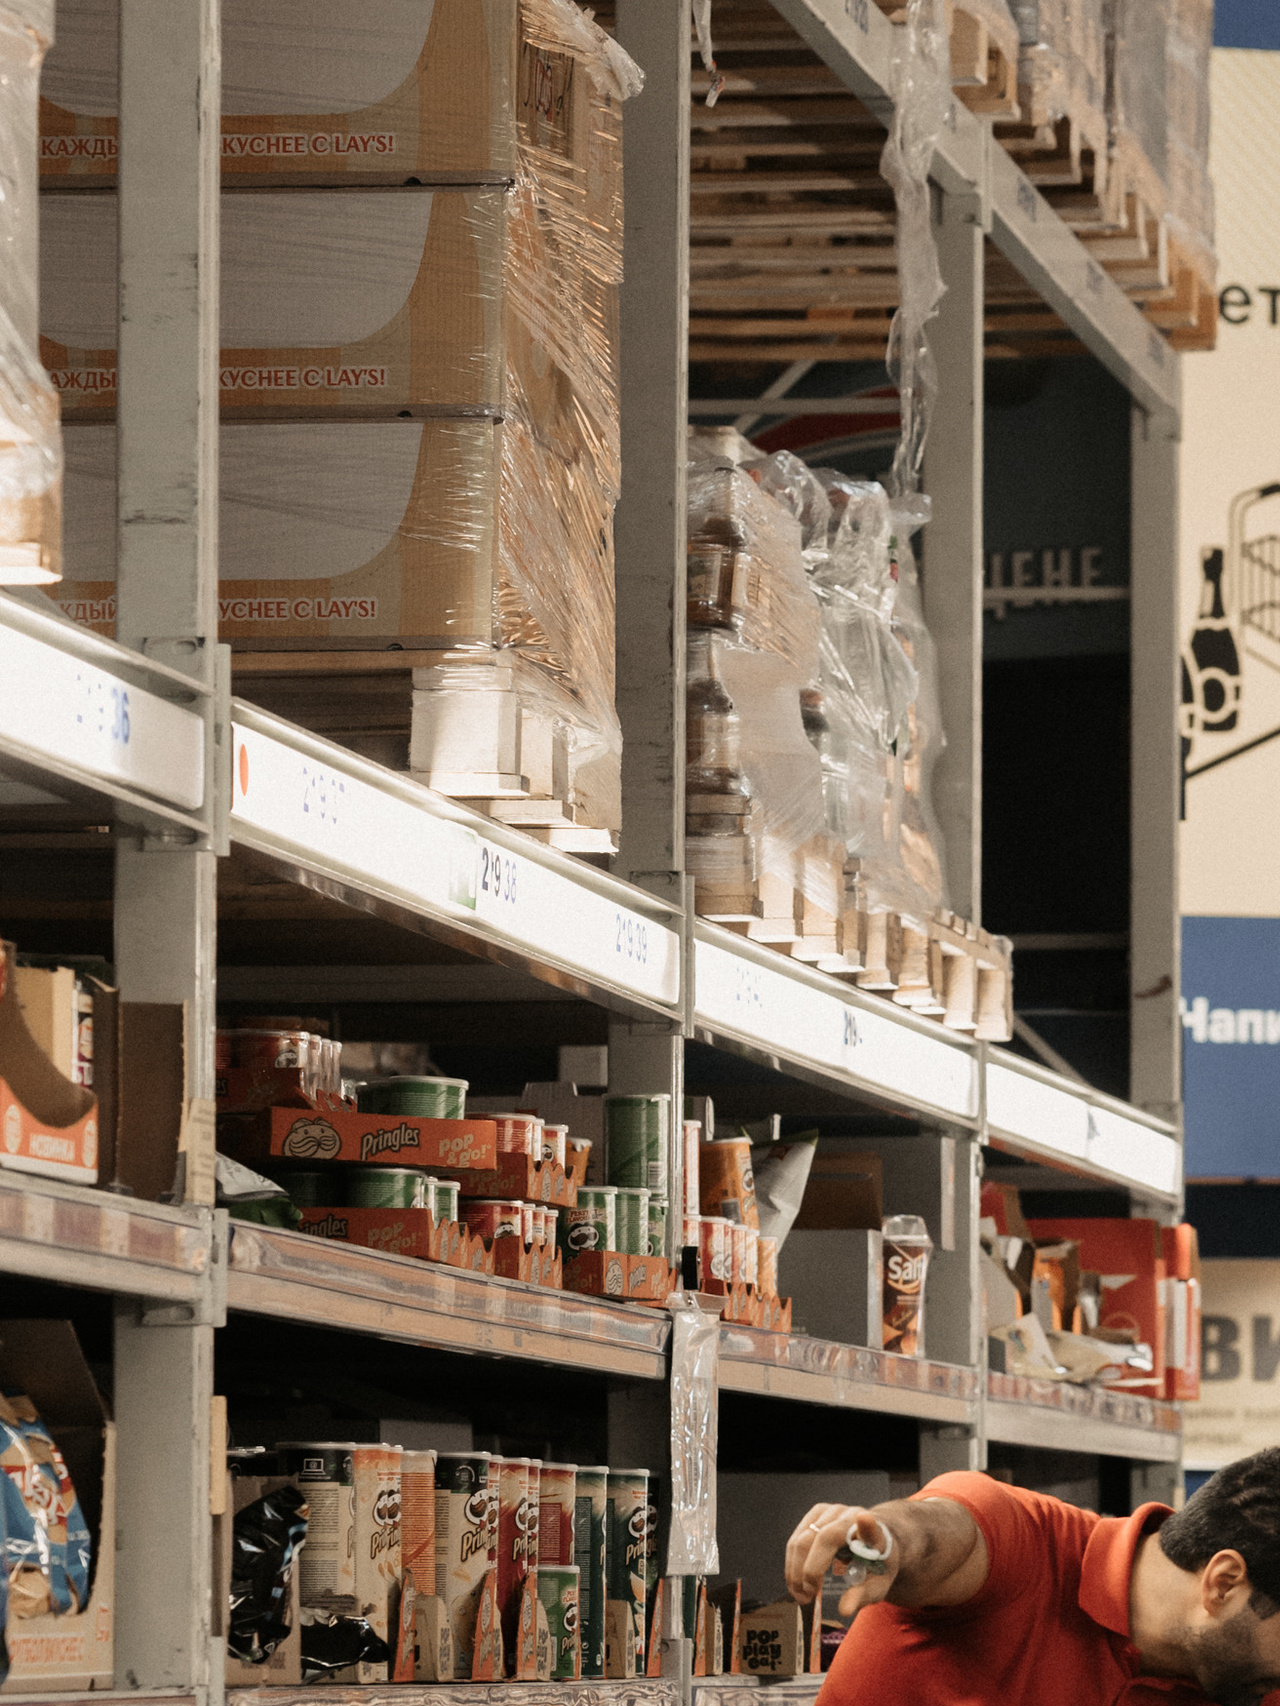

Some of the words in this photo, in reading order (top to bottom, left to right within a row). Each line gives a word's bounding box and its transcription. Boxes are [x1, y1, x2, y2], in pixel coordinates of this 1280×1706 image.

[335, 134, 393, 153] LAY'S!
[326, 368, 386, 386] LAY'S!
[317, 600, 376, 619] LAY'S!
[360, 1122, 420, 1162] Pringles
